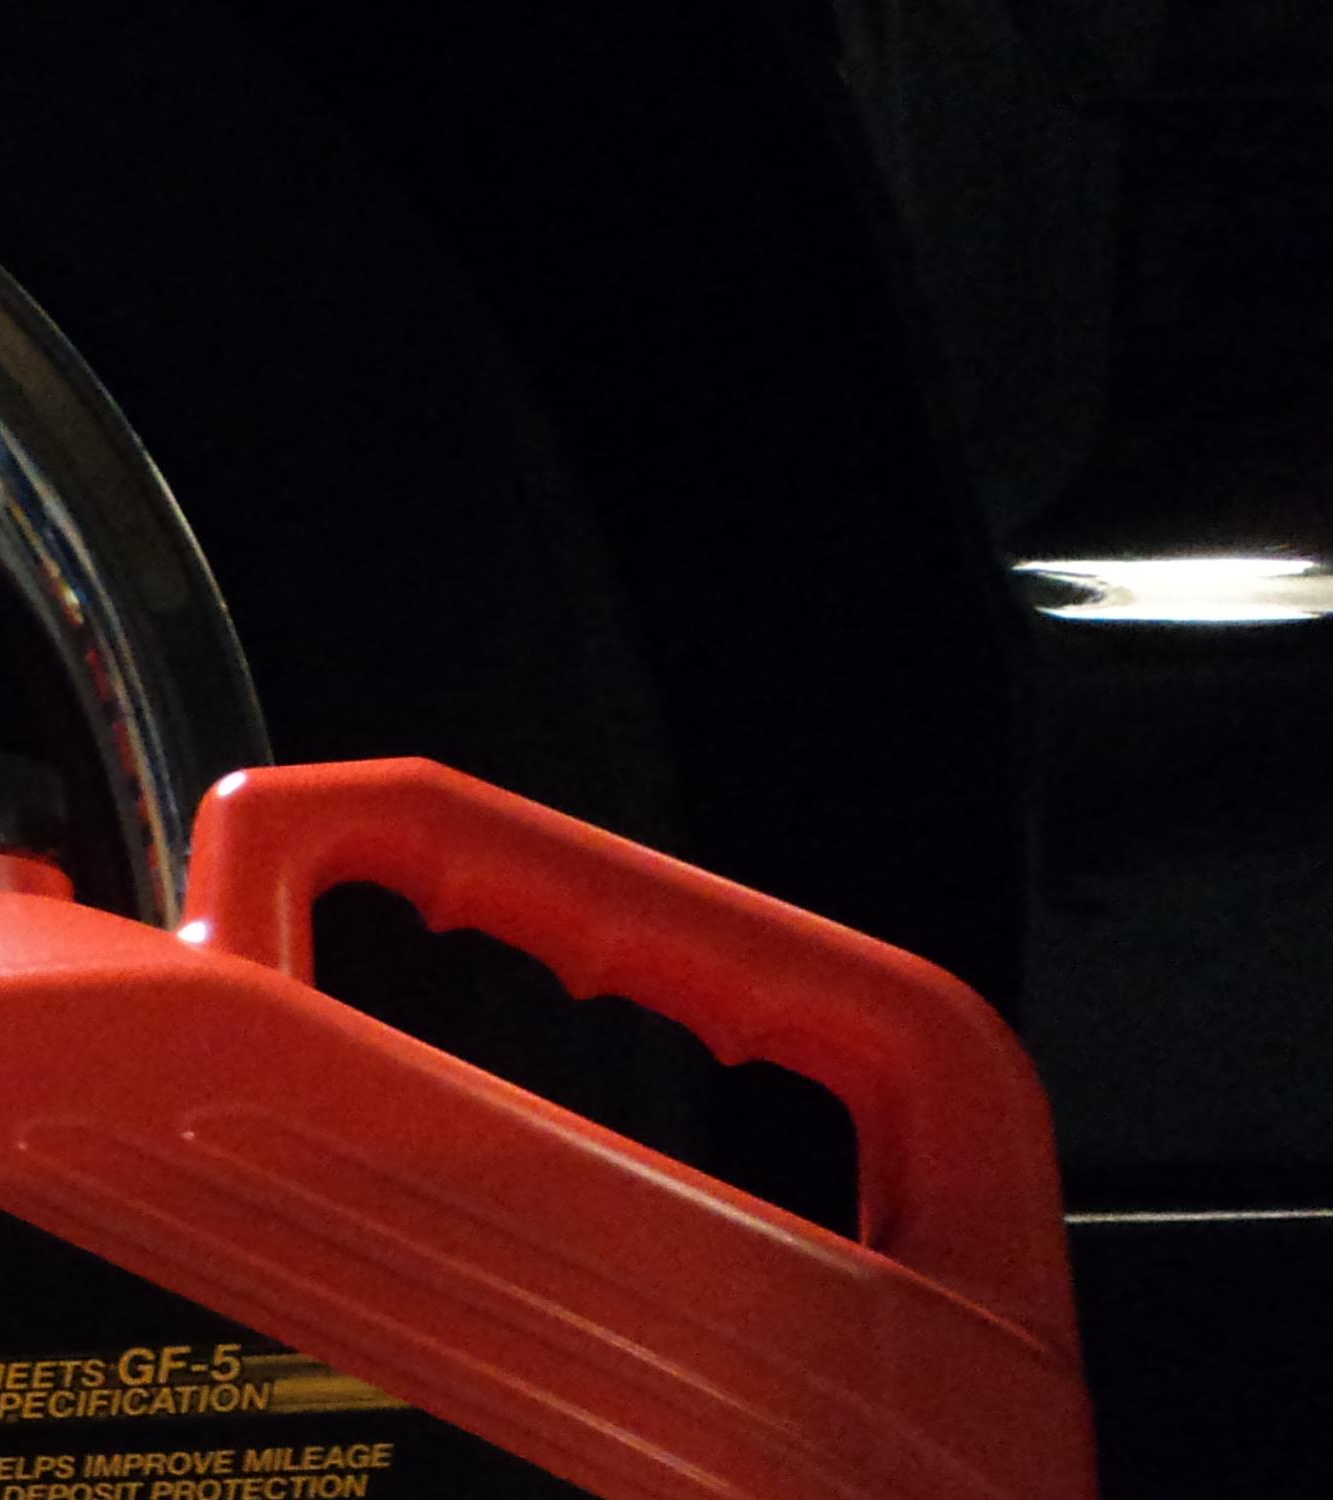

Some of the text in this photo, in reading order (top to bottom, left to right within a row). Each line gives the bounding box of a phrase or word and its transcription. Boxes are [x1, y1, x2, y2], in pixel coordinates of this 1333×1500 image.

[117, 1345, 241, 1388] GF-5
[82, 1447, 233, 1478] IMPROVE
[242, 1444, 394, 1473] MILEAGE
